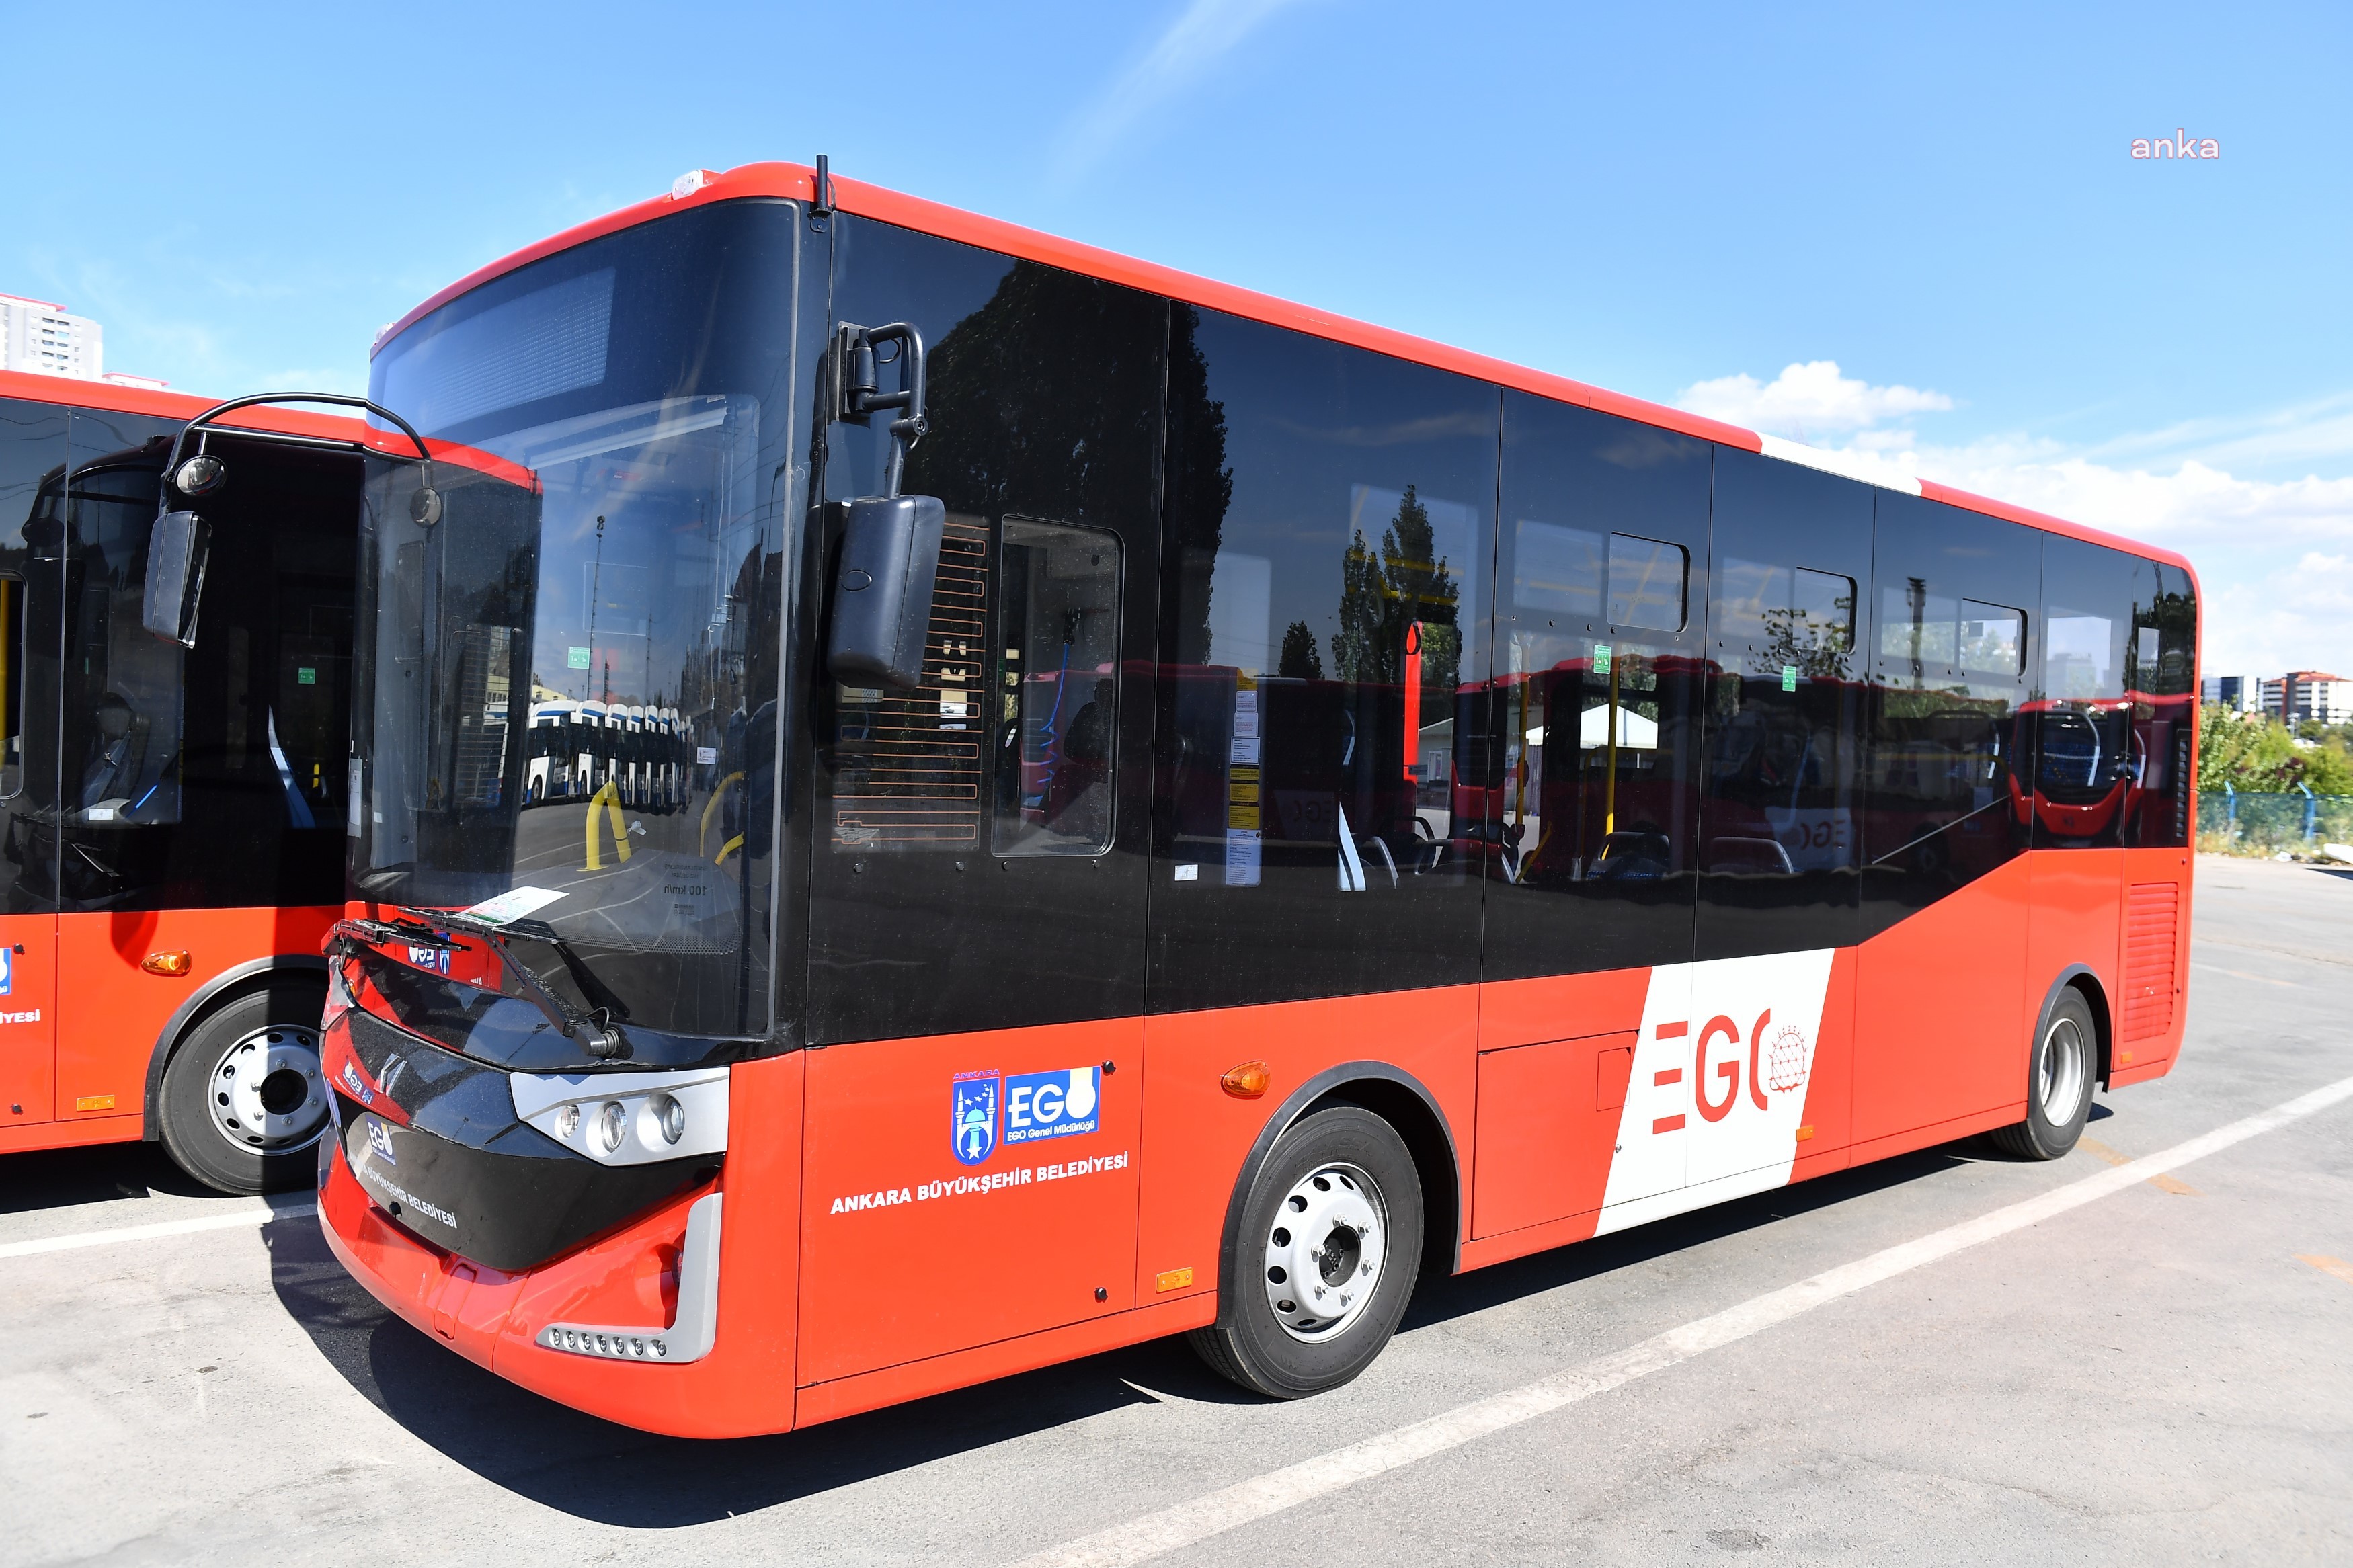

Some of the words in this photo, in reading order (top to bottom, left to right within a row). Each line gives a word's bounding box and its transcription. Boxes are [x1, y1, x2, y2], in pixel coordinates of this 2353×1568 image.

[953, 1069, 1000, 1080] ANKARA
[1008, 1079, 1096, 1128] EGO
[368, 1122, 393, 1156] EGO
[1007, 1130, 1027, 1142] EGO
[1027, 1126, 1053, 1139] Genel
[1053, 1120, 1095, 1135] Müdürlüğü
[830, 1187, 912, 1214] ANKARA
[917, 1167, 1031, 1200] BÜYÜKŞEHİR
[1036, 1151, 1129, 1182] BELEDİYESİ
[407, 1193, 458, 1229] BELEDİYESİ
